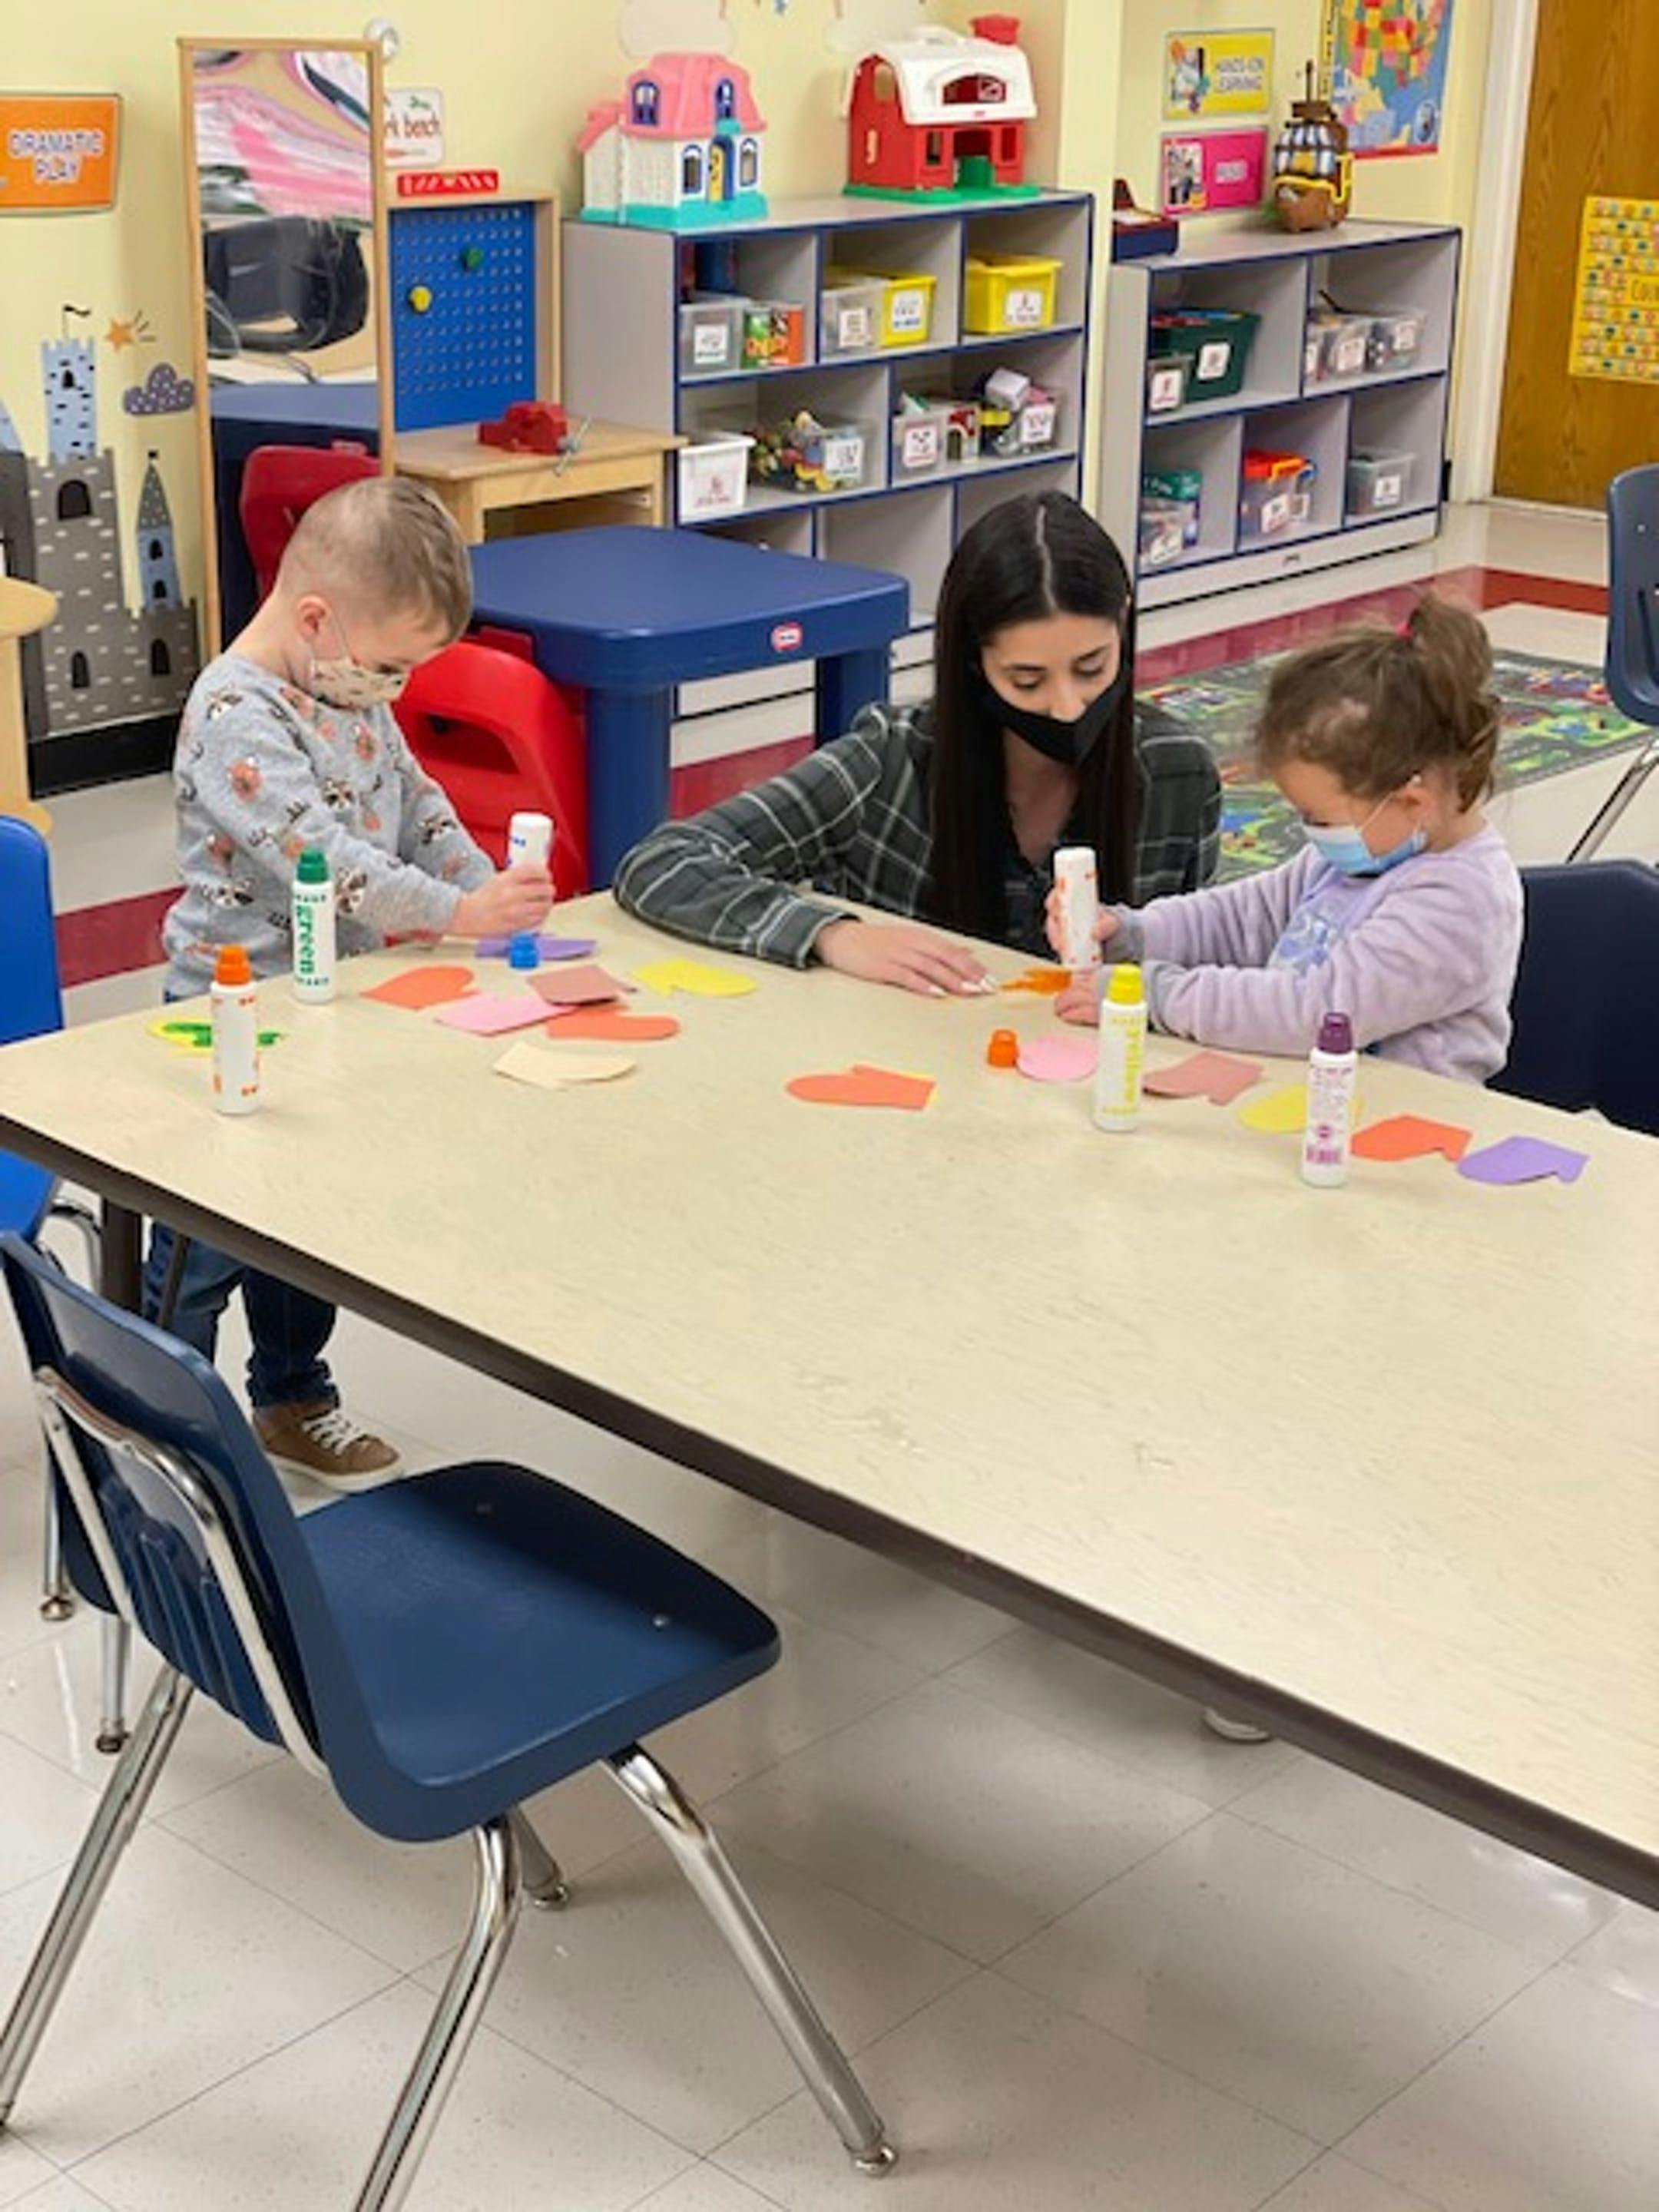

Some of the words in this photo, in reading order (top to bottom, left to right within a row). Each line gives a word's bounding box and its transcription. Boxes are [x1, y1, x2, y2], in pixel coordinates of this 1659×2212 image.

[9, 129, 103, 157] DRAMATIC
[35, 154, 79, 183] PLAY
[296, 904, 315, 975] green
[1124, 1027, 1141, 1103] yellow
